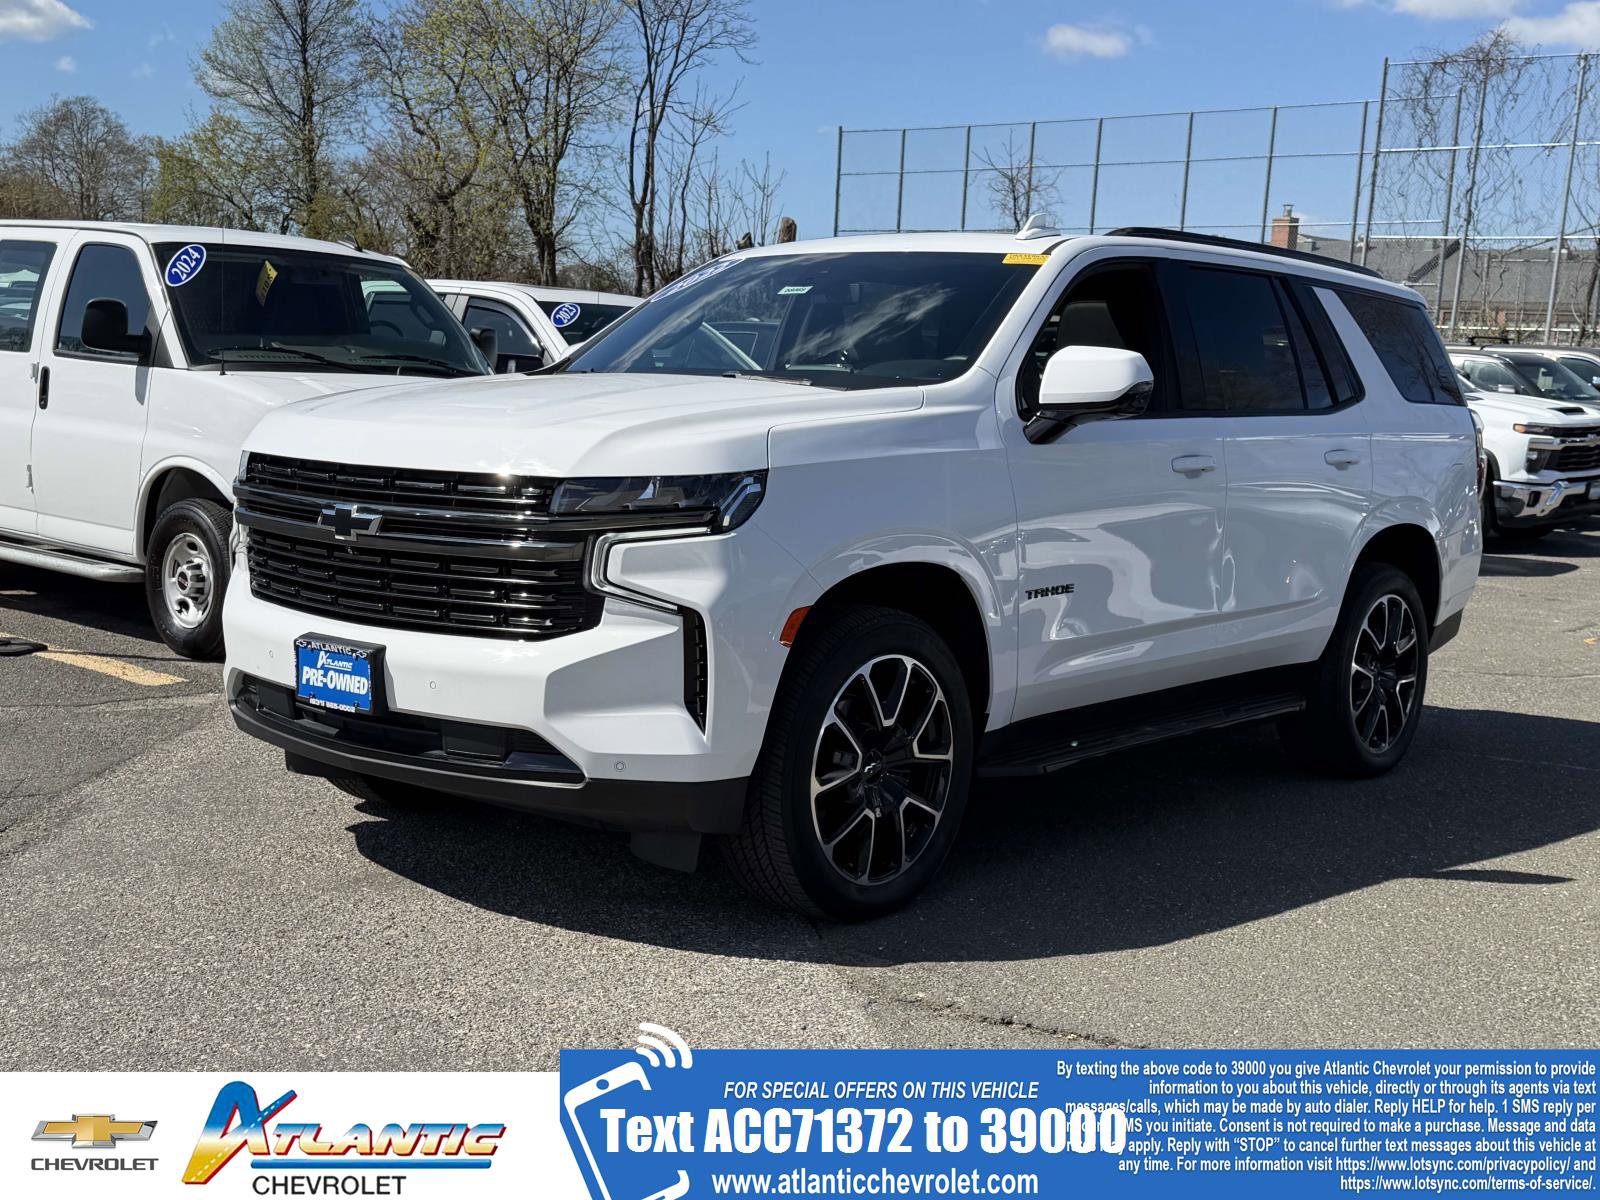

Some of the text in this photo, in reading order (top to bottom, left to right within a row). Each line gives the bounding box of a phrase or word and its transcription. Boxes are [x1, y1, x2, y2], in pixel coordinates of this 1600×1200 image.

[172, 247, 201, 281] 2024
[556, 304, 577, 324] 2023
[1025, 583, 1074, 600] TAHOE
[311, 641, 352, 655] ATLANTIC
[302, 666, 368, 695] PRE-OWNED
